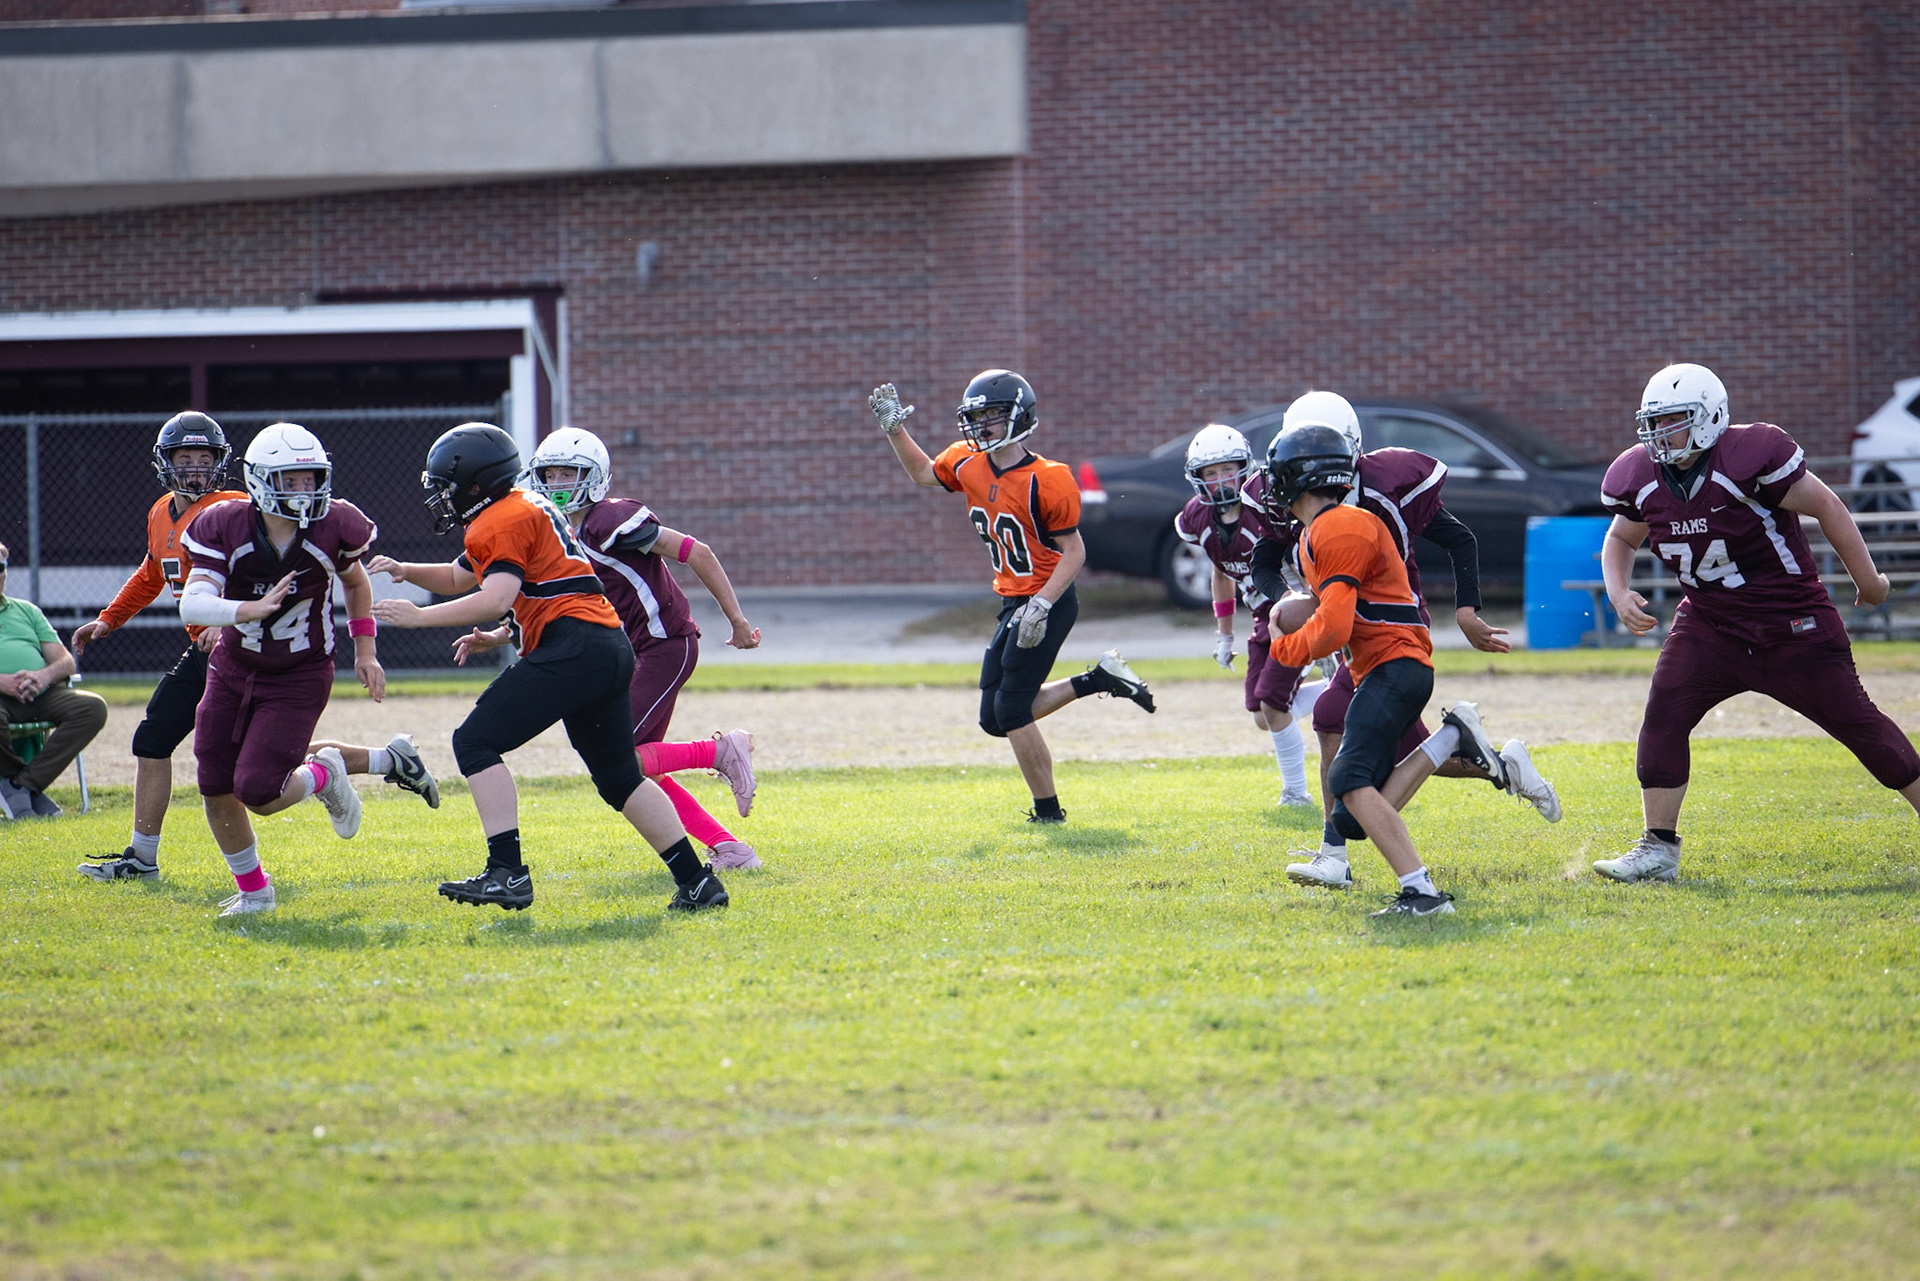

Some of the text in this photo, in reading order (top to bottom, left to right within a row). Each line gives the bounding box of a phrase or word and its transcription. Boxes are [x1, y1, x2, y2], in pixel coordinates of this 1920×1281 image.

[1670, 518, 1709, 535] RAMS
[1221, 561, 1250, 574] RAMS
[1658, 539, 1746, 589] 74
